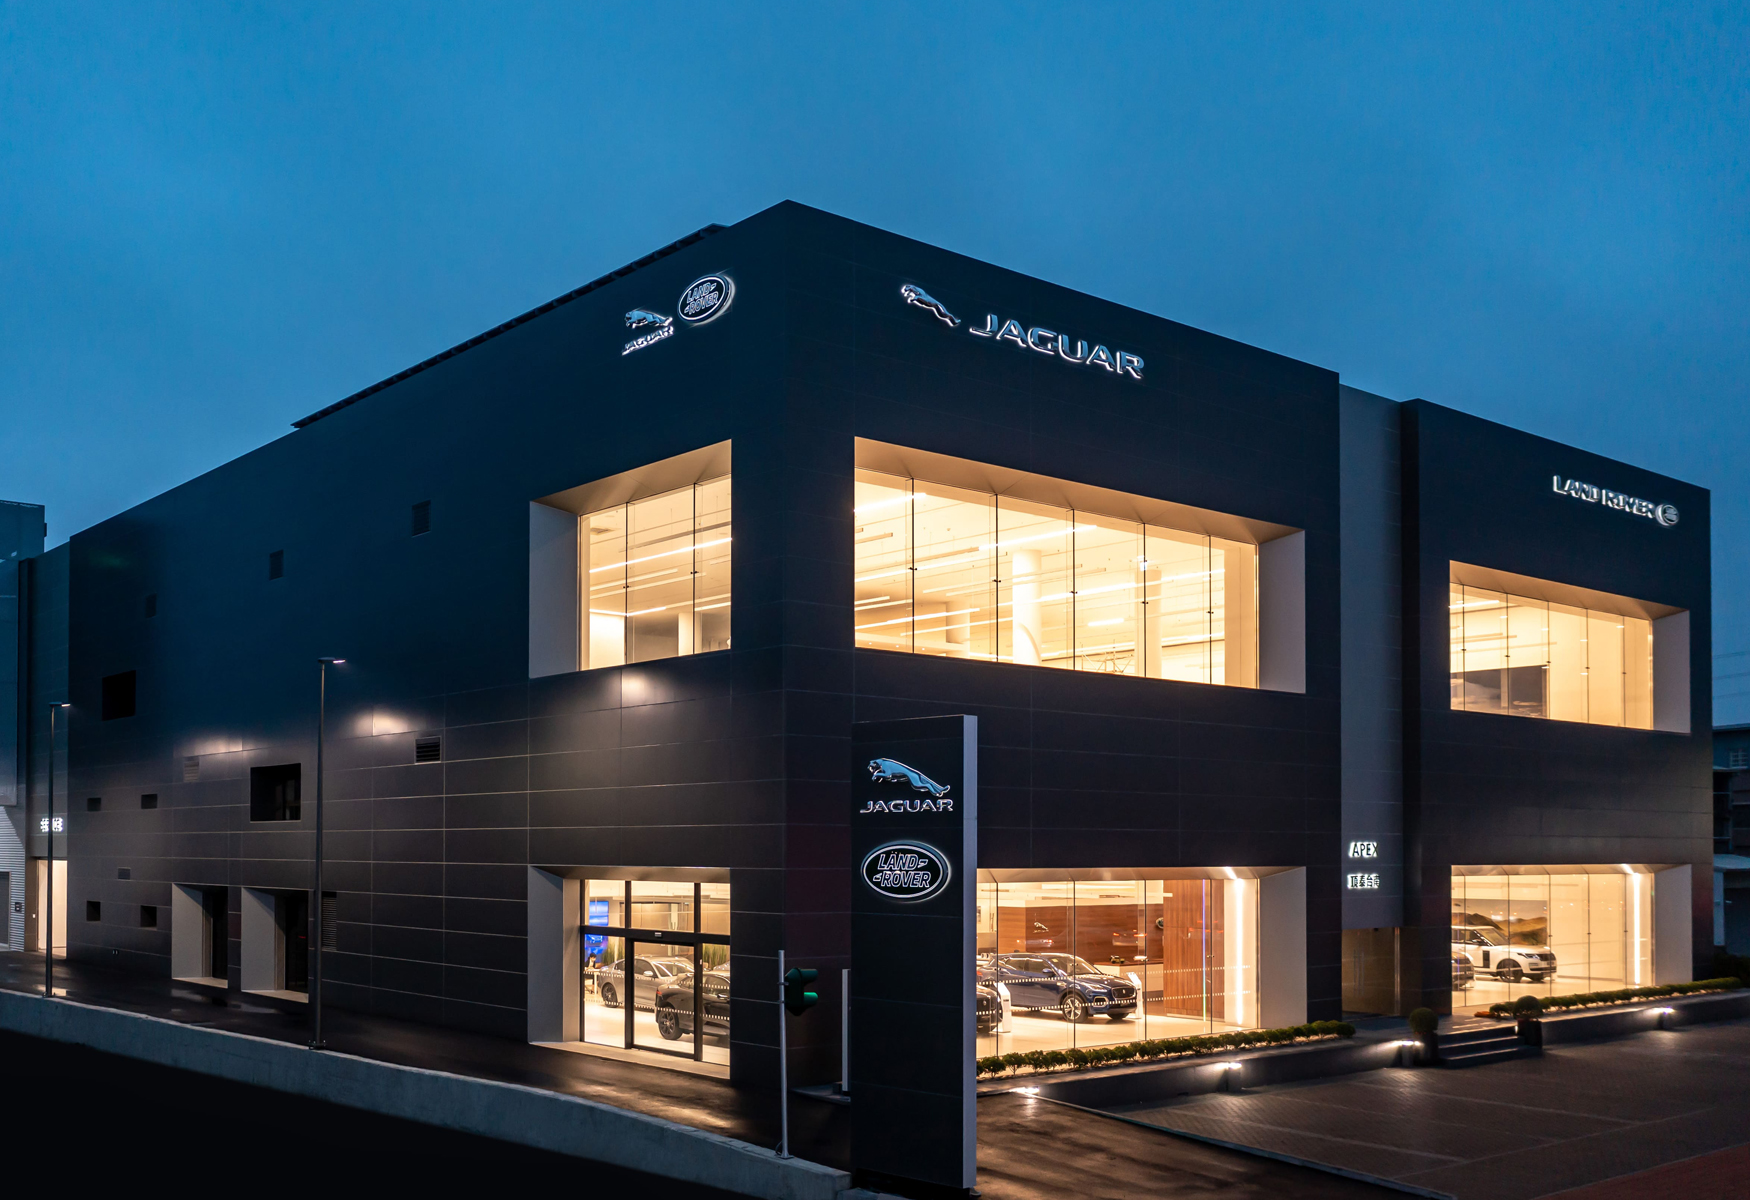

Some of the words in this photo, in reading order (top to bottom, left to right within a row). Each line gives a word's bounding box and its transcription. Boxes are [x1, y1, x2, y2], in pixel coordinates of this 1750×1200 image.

[688, 291, 719, 315] ROVER
[969, 314, 1145, 379] JAGUAR
[1552, 475, 1600, 503] LAND
[1601, 488, 1656, 519] ROVER
[860, 799, 953, 813] JAGUAR
[1350, 842, 1379, 857] APEX
[878, 853, 919, 870] LAND
[880, 870, 931, 888] ROVER
